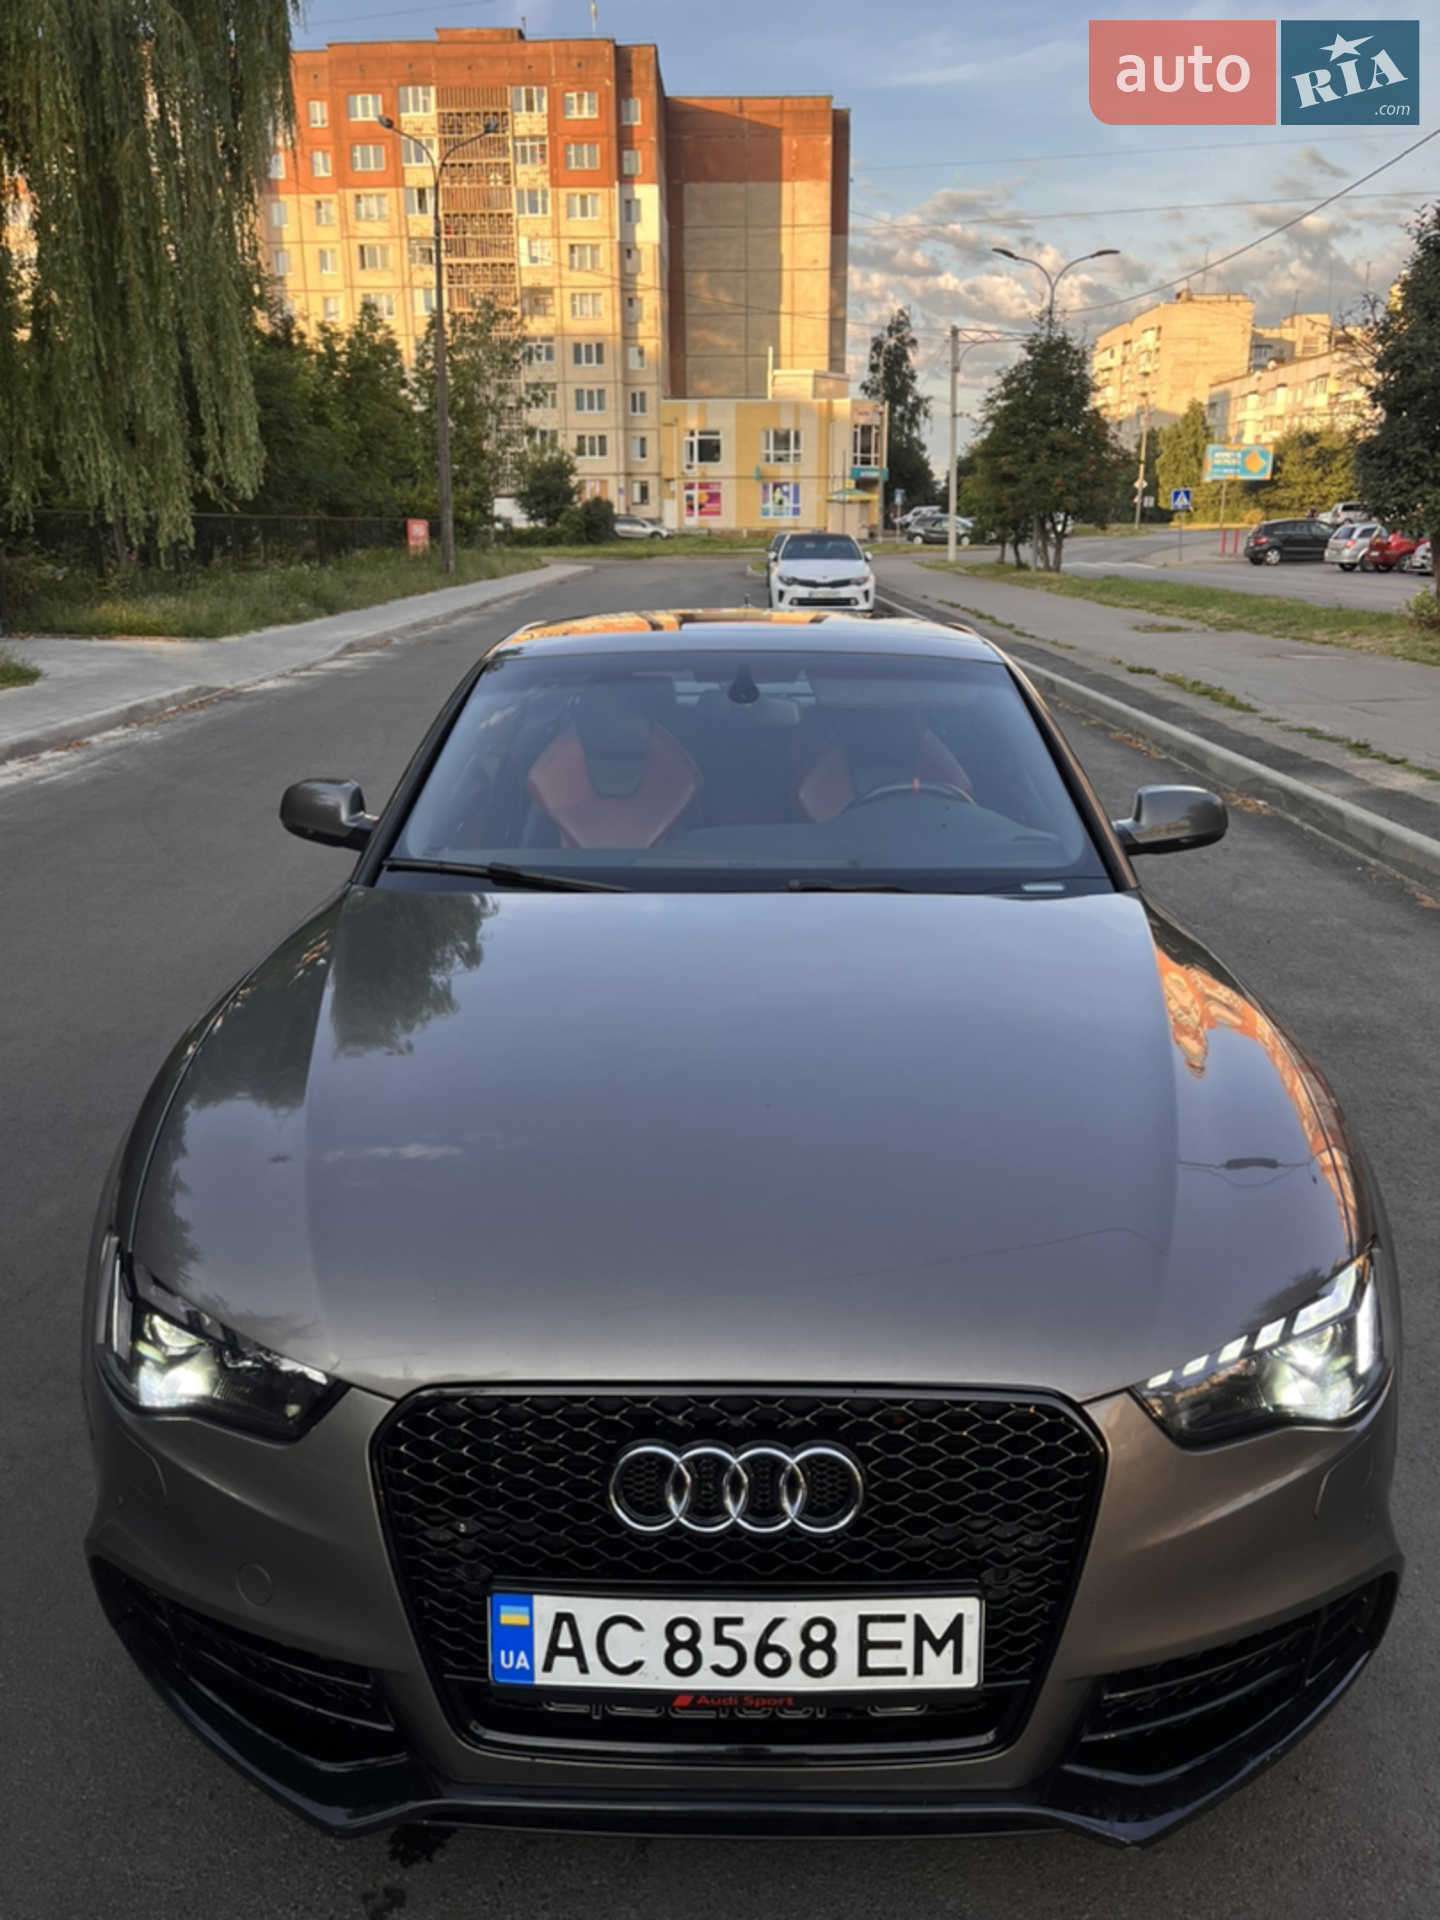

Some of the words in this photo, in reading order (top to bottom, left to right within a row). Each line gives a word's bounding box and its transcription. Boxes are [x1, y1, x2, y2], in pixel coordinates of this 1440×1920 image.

[541, 1611, 646, 1677] AC
[664, 1615, 838, 1679] 8568
[857, 1612, 964, 1677] EM
[500, 1650, 531, 1671] UA
[696, 1694, 739, 1706] Audi
[743, 1695, 795, 1707] Sport
